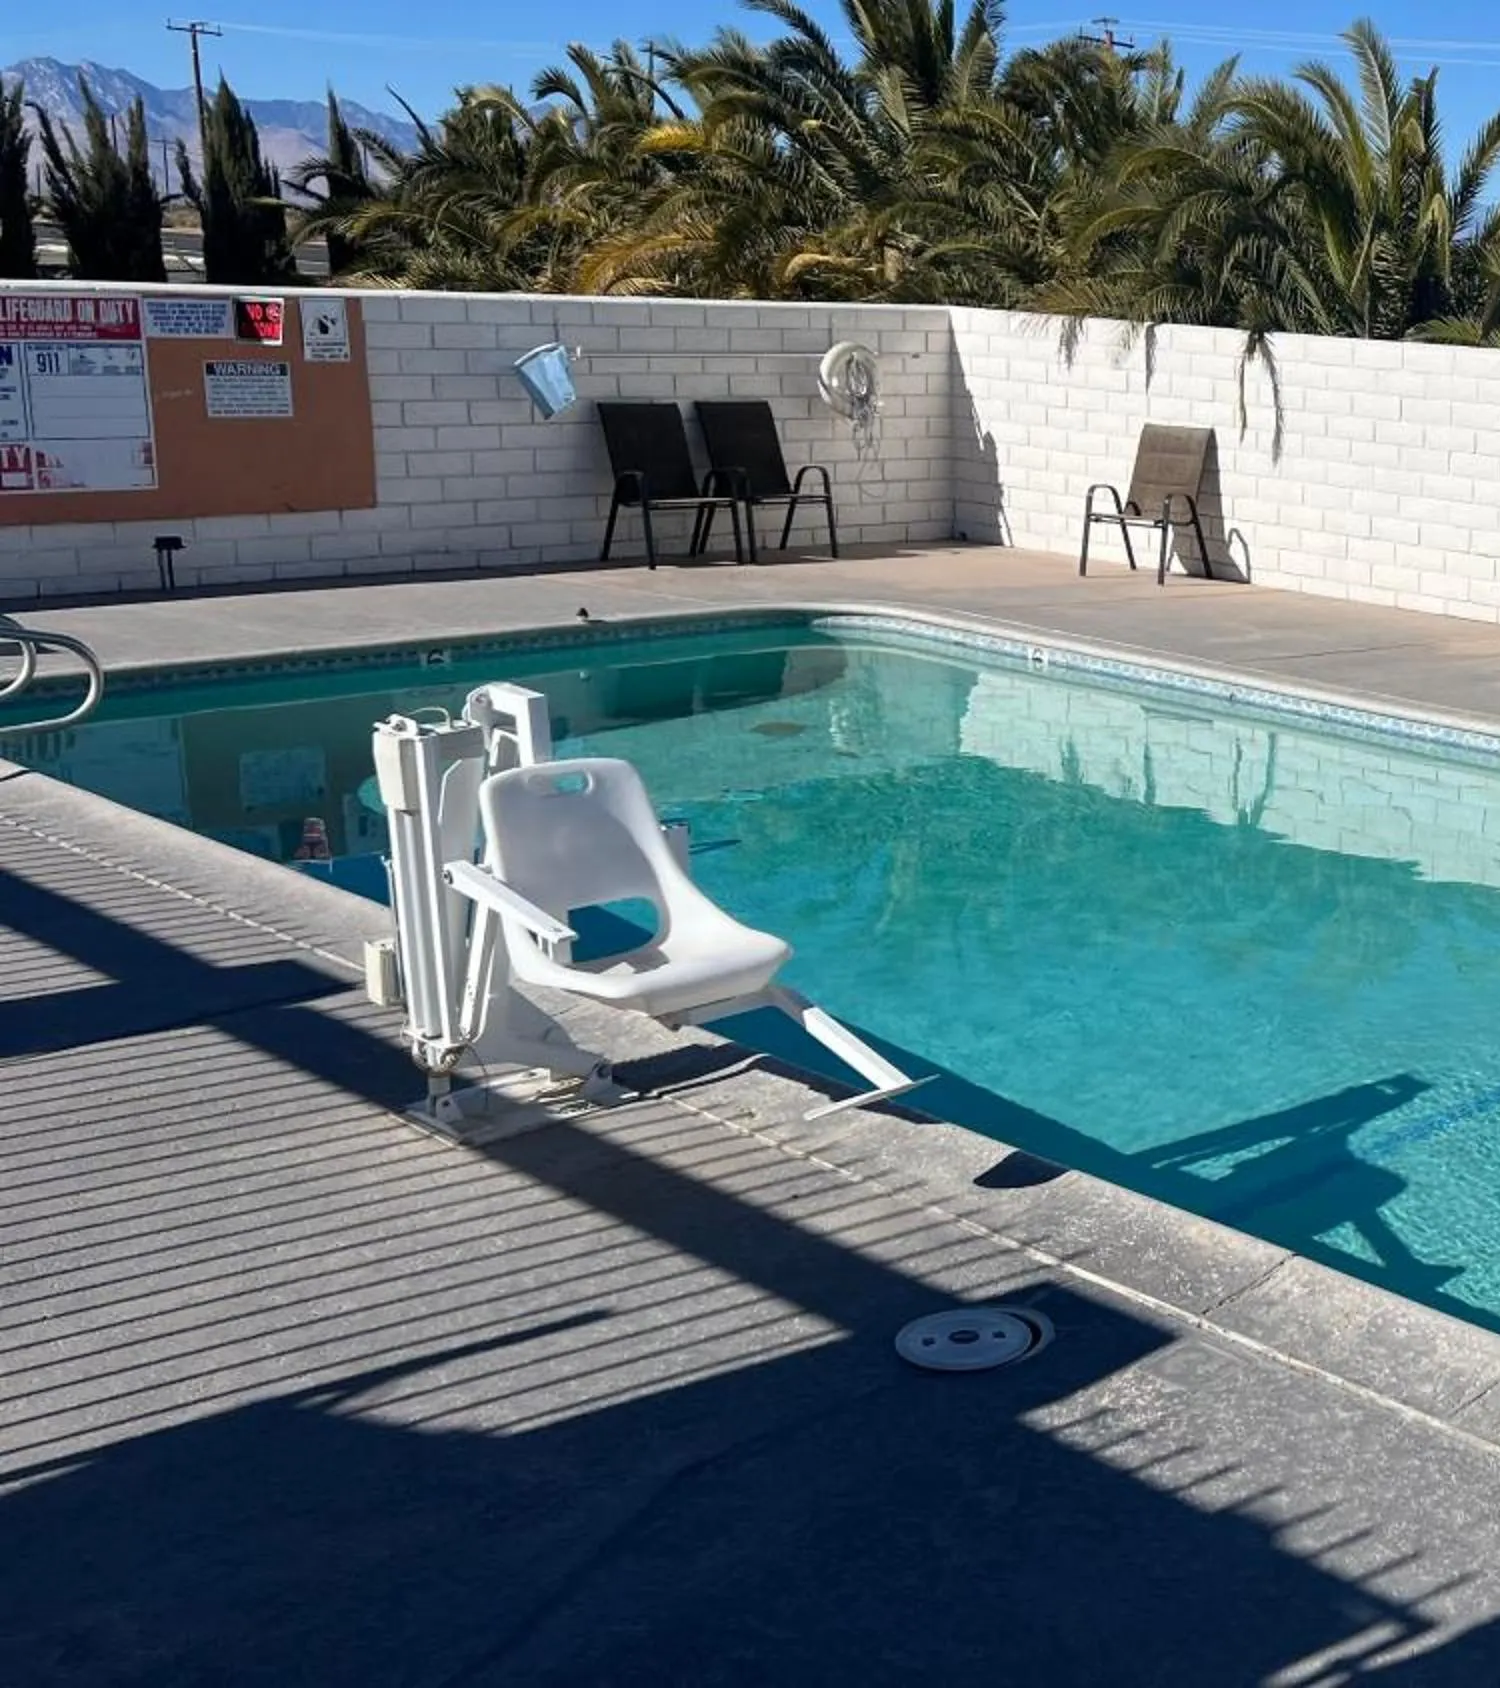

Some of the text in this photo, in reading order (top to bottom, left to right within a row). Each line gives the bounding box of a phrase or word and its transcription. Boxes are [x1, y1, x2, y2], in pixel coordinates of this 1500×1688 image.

[77, 299, 95, 322] ON
[99, 299, 135, 323] DUTY
[37, 352, 60, 373] 911
[213, 363, 281, 376] WARNING
